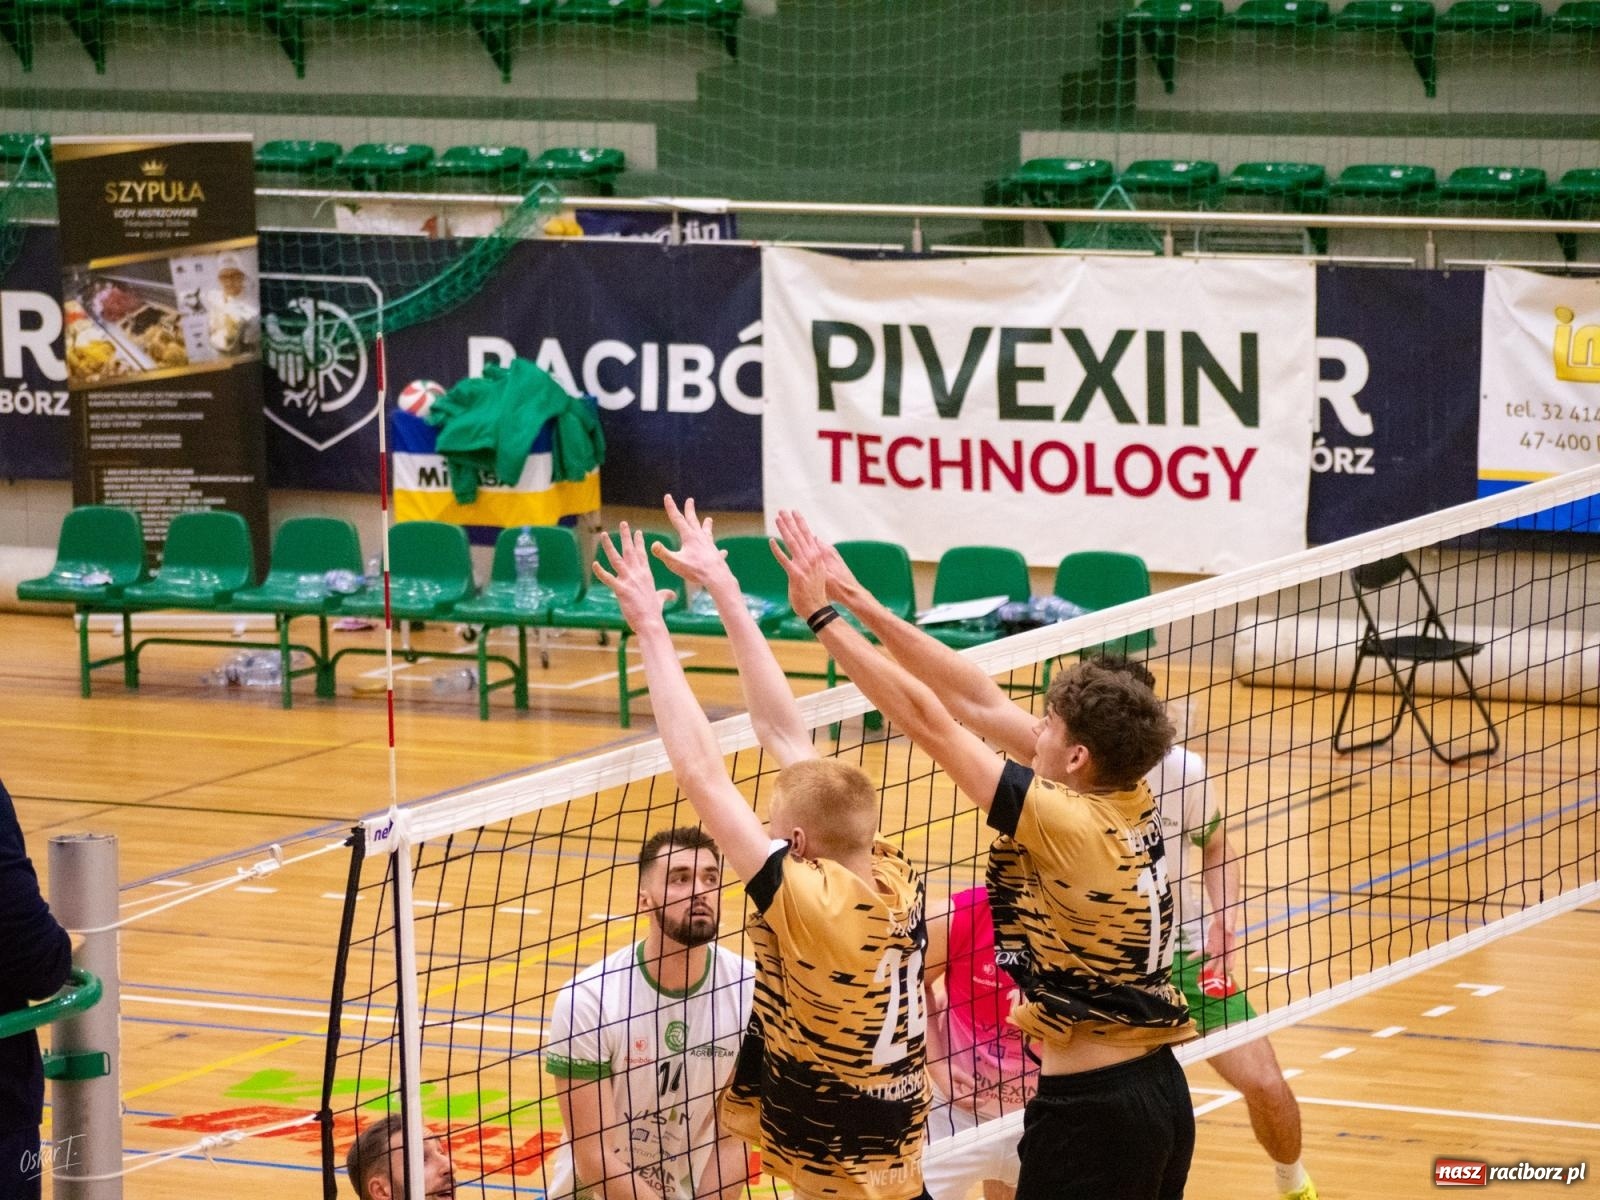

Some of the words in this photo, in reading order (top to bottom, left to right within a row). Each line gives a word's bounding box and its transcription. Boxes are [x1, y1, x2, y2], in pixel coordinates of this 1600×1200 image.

[104, 181, 205, 203] SZYPUŁA
[1, 290, 69, 381] R
[811, 320, 1260, 428] PIVEXIN
[1505, 401, 1536, 418] tel.
[1541, 402, 1564, 421] 32
[1311, 438, 1375, 475] ÓRZ
[1519, 432, 1592, 450] 47-400
[817, 430, 1259, 502] TECHNOLOGY
